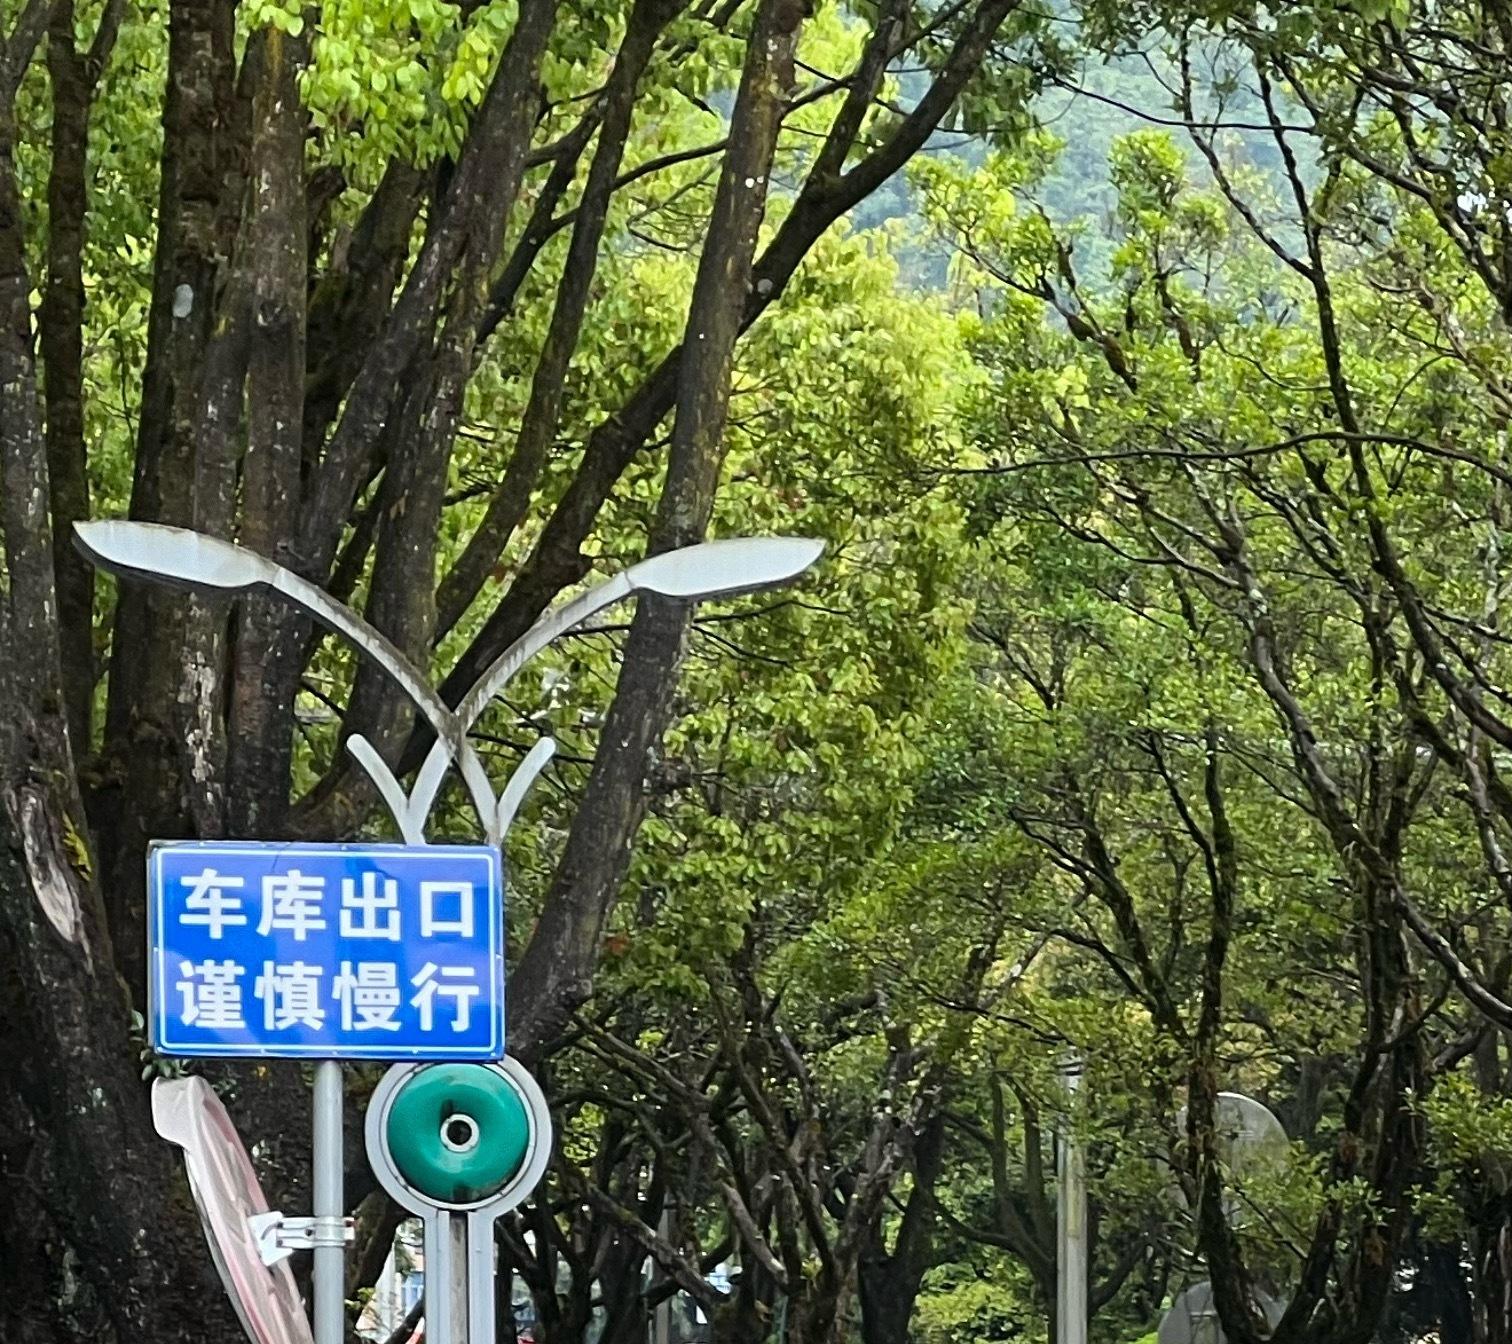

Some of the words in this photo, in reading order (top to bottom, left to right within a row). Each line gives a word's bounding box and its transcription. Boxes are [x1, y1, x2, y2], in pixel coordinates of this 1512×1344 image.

[179, 868, 475, 941] 车库出口
[176, 959, 480, 1032] 谨慎慢行
